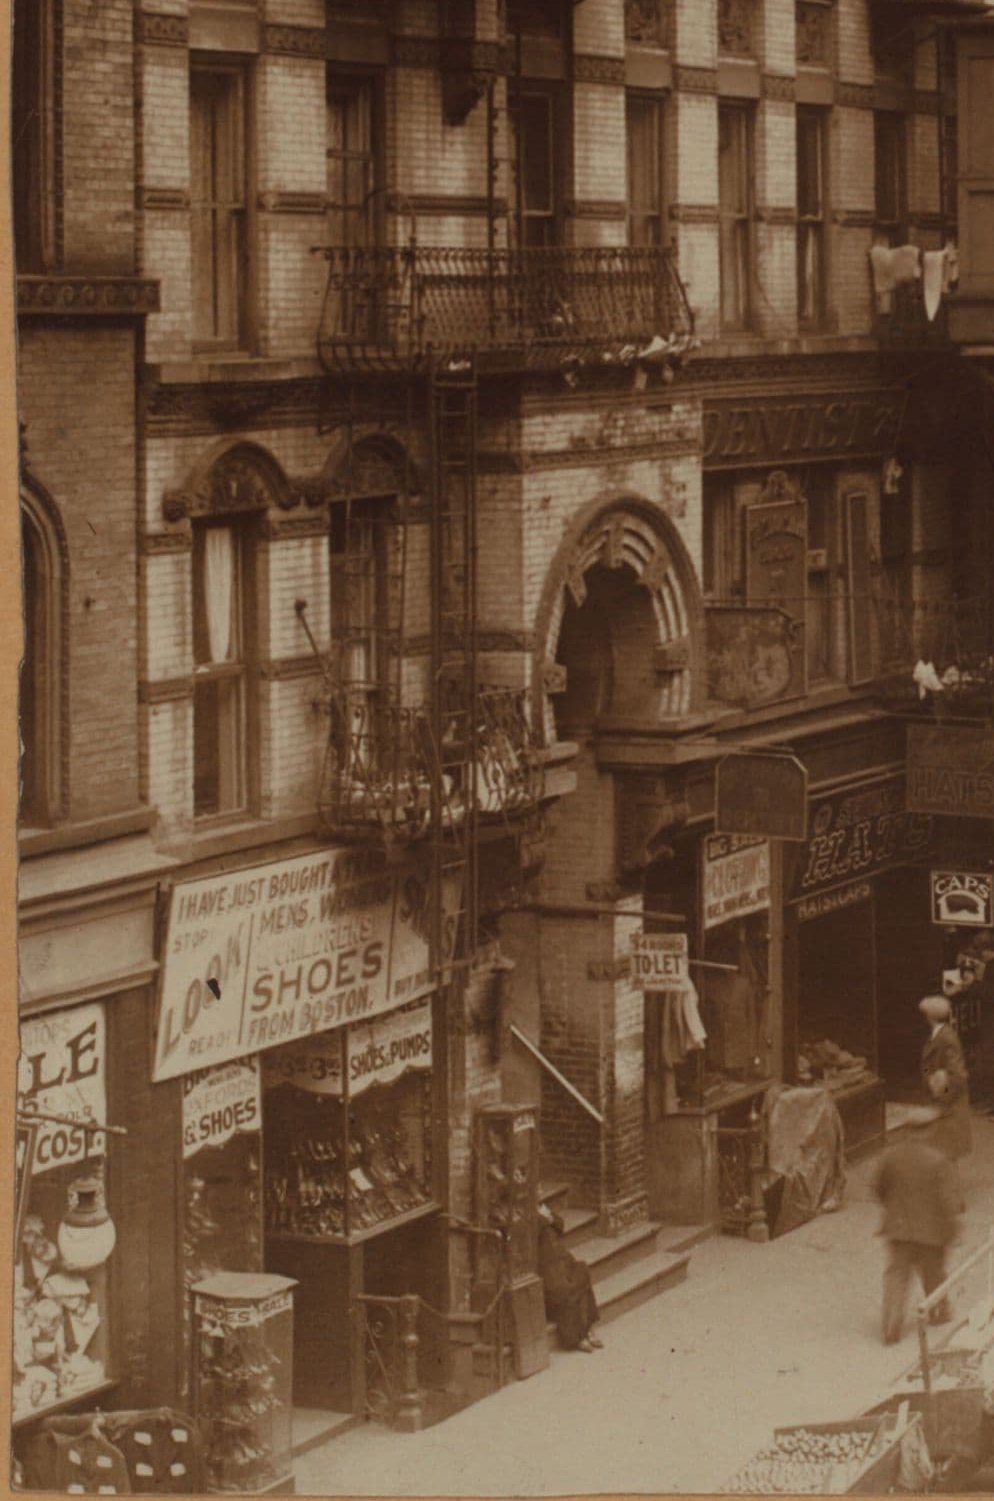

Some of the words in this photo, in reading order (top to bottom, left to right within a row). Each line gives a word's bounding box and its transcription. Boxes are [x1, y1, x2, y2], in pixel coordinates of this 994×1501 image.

[702, 402, 873, 458] DENTIST
[802, 813, 934, 888] HATS
[176, 895, 185, 923] I
[185, 885, 228, 918] HAVE
[229, 876, 267, 910] JUST
[268, 861, 331, 901] BOUGHT
[935, 876, 992, 900] CAPS
[160, 921, 246, 1062] LOOK
[251, 941, 384, 1014] SHOES
[249, 1008, 294, 1048] FROM
[299, 985, 374, 1032] BOSTON.
[351, 1045, 385, 1080] SHOES
[391, 1030, 432, 1063] PUMPS
[200, 1097, 258, 1140] SHOES
